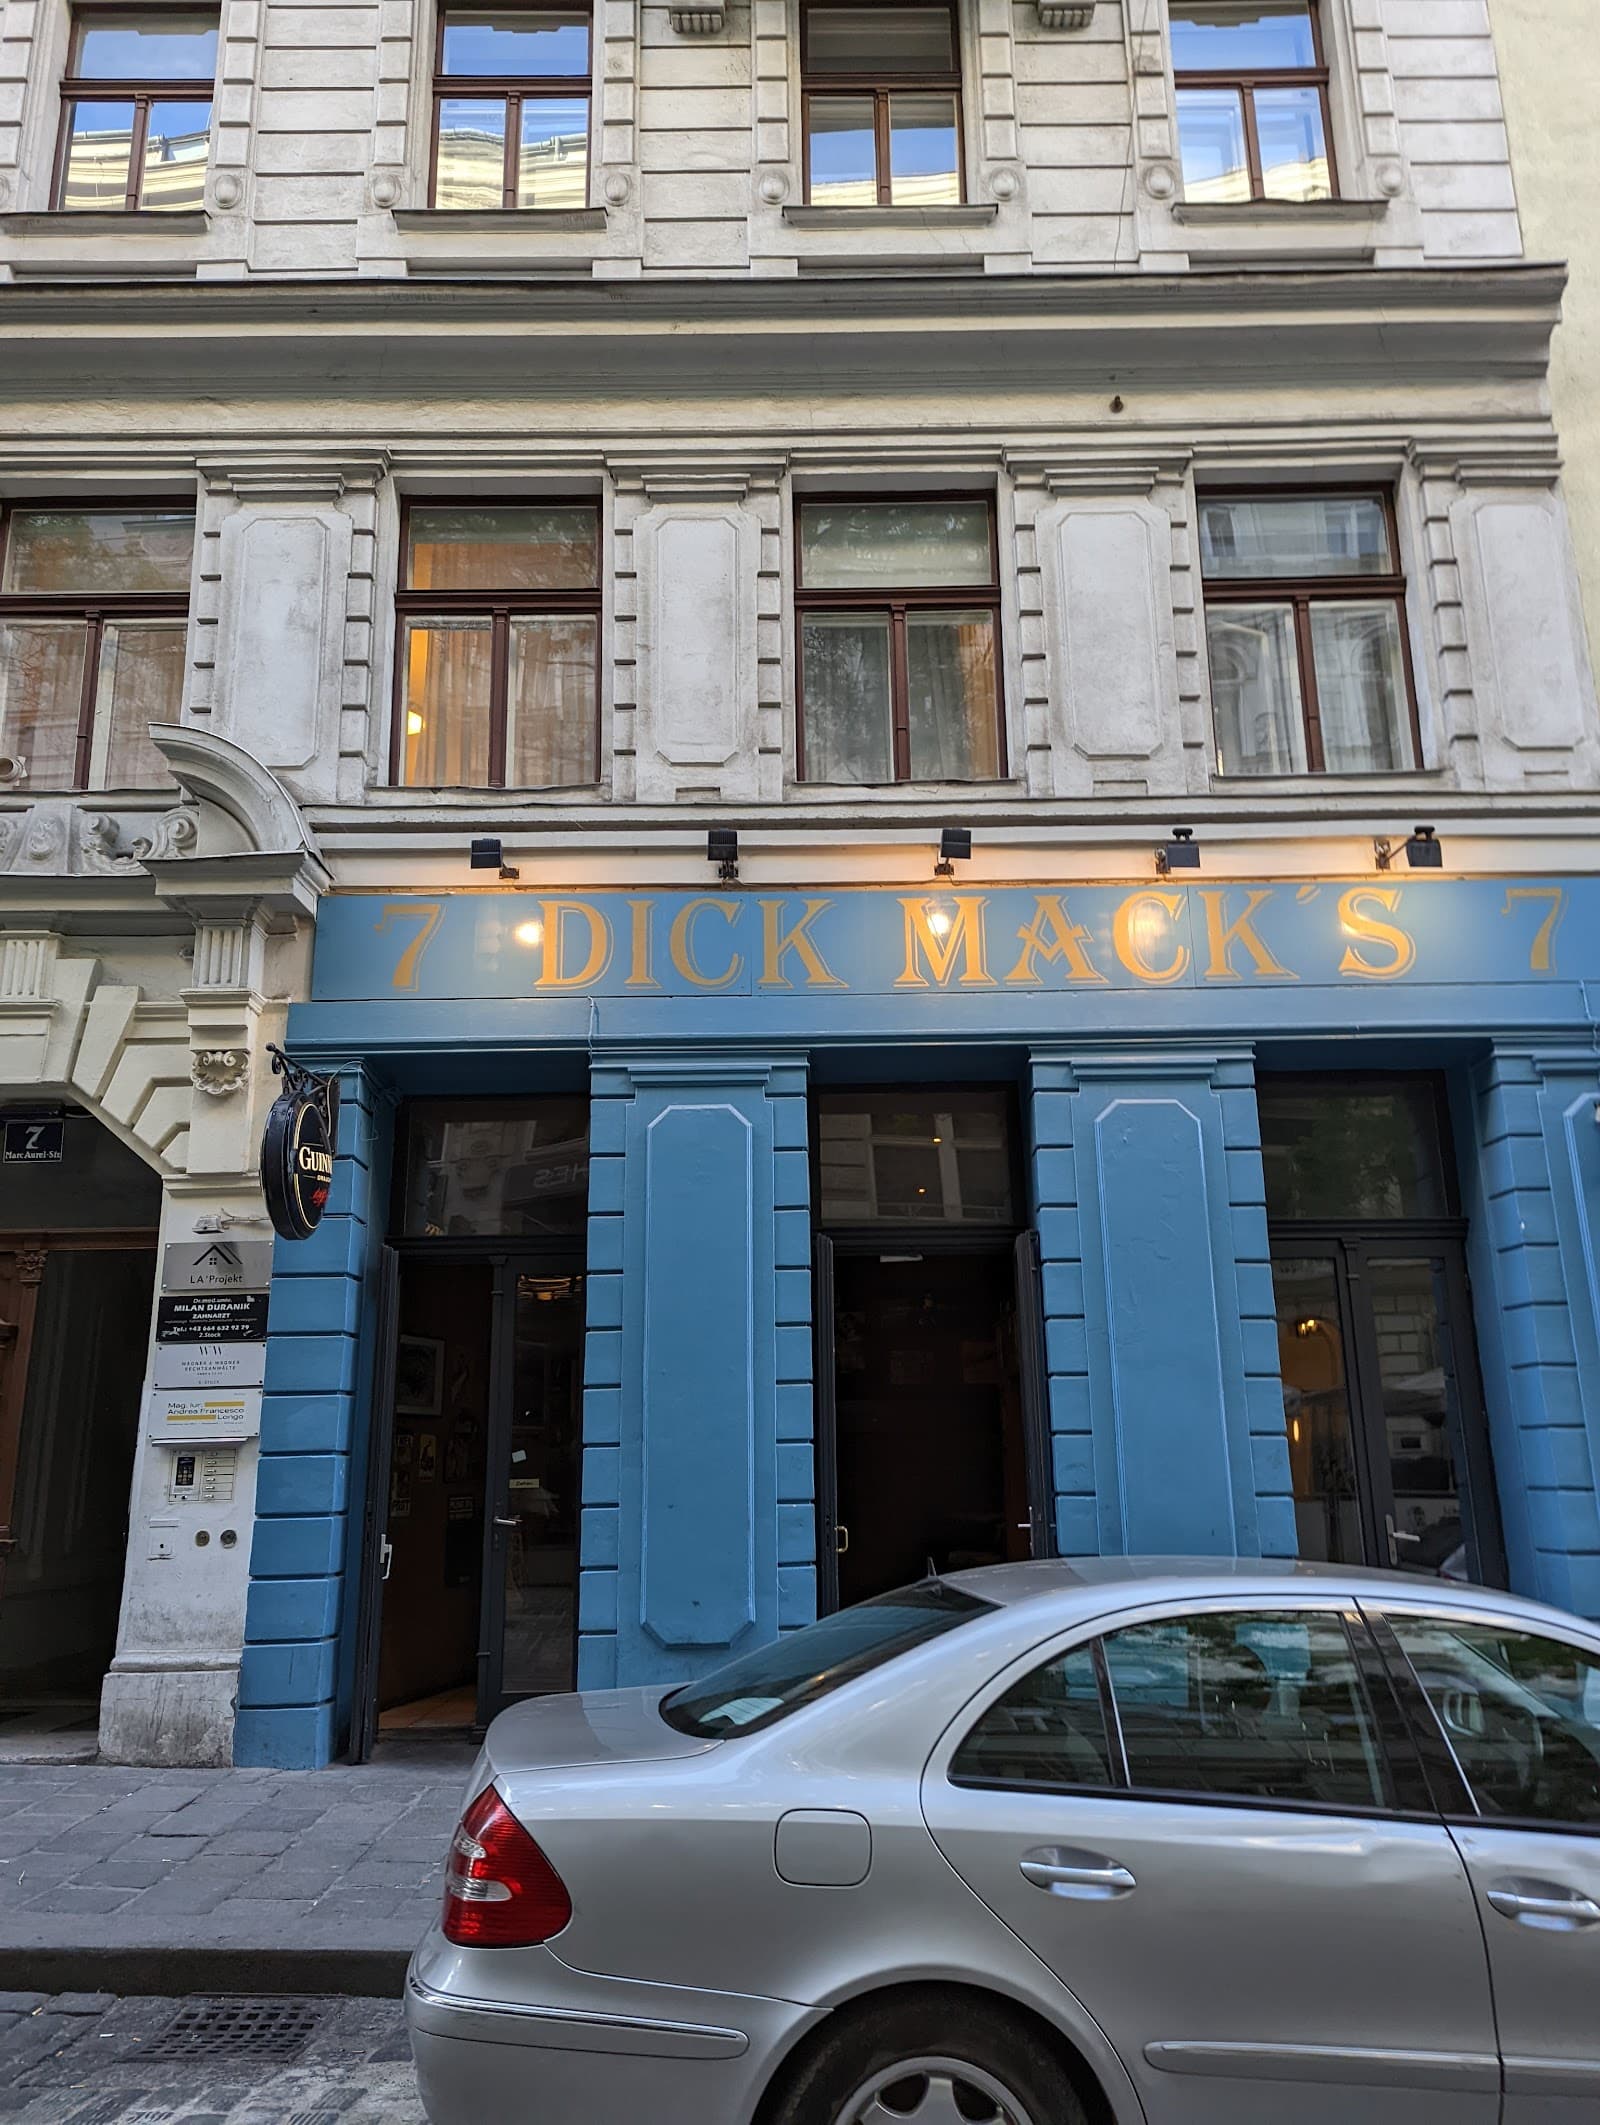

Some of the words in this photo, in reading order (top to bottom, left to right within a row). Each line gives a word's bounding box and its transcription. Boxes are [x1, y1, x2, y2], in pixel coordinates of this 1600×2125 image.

[375, 902, 448, 993] 7
[533, 898, 850, 993] DICK
[1501, 886, 1568, 978] 7
[25, 1125, 46, 1150] 7
[5, 1151, 24, 1160] Marc
[174, 1304, 205, 1312] MILAN
[207, 1303, 250, 1311] DURANIK
